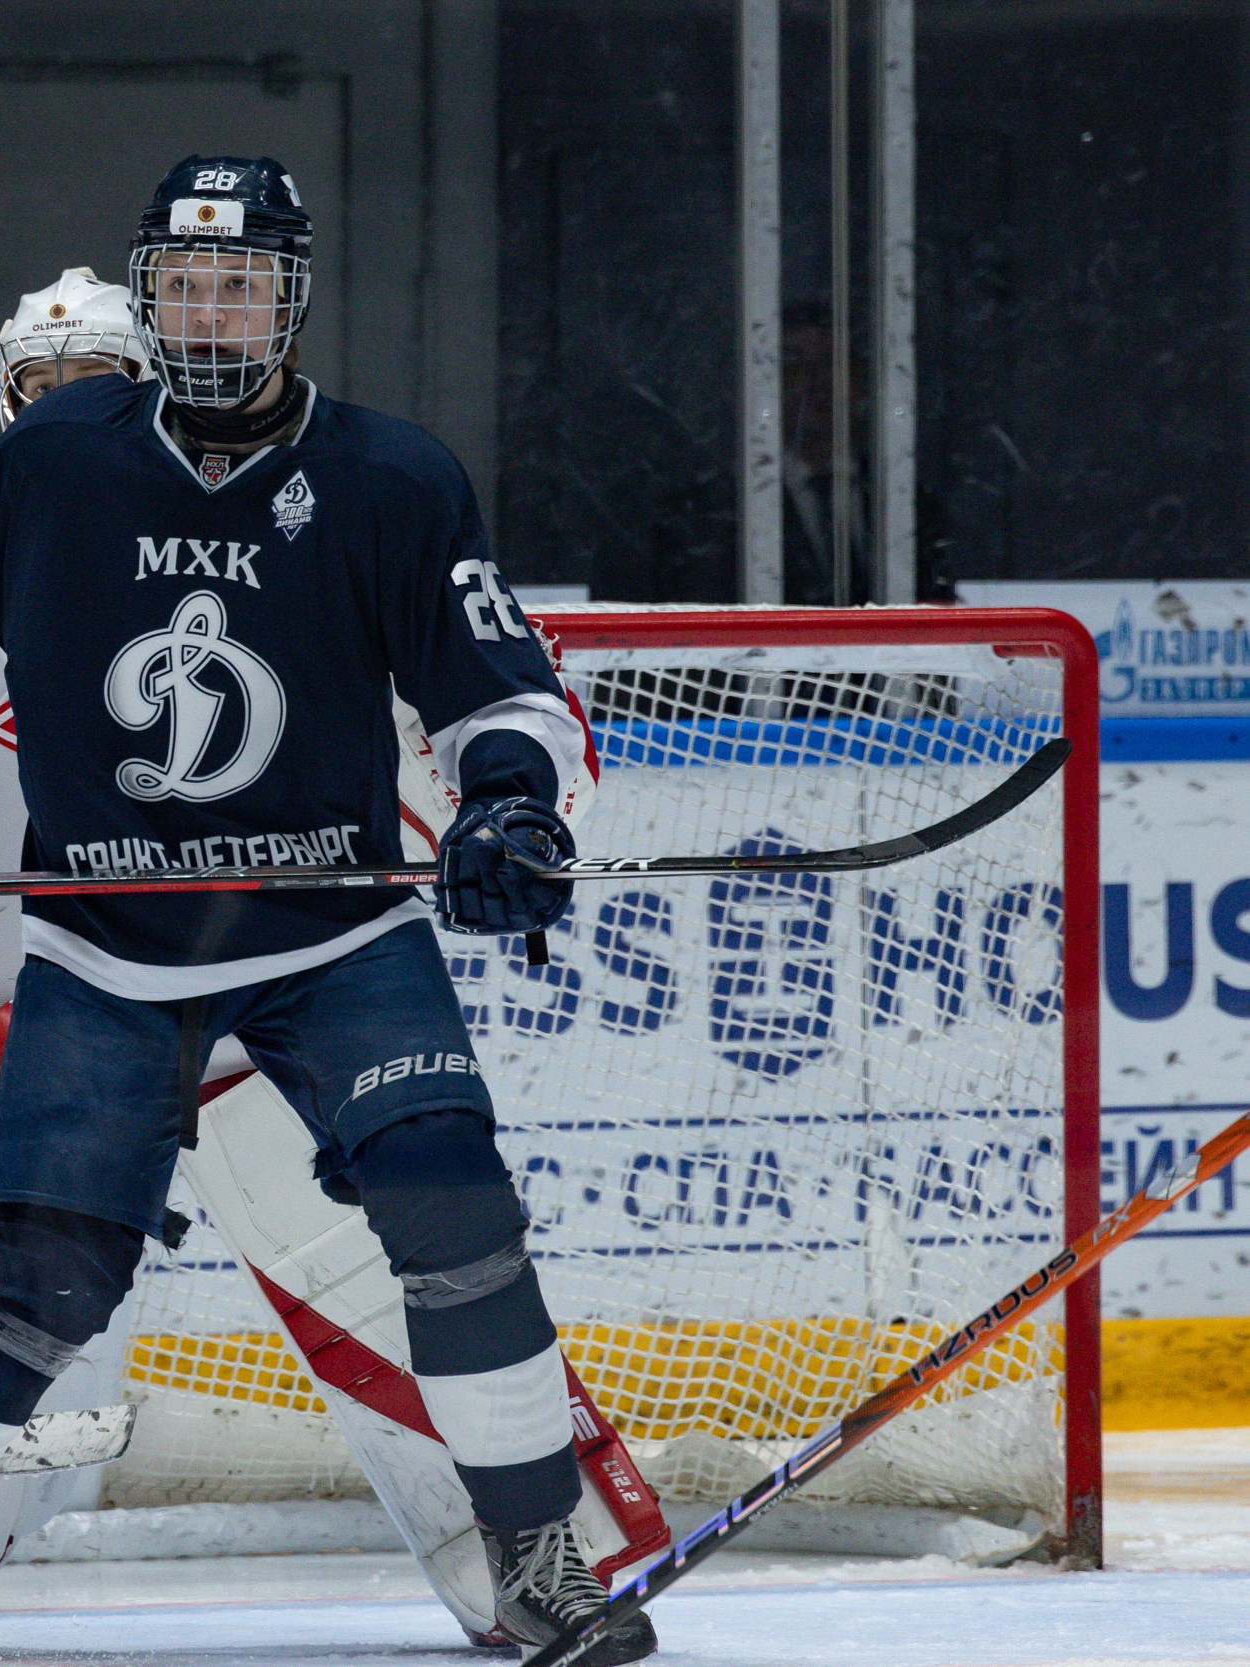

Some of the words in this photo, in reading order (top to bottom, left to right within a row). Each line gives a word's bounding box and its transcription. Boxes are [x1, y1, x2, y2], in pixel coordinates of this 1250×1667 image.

[194, 170, 238, 190] 28
[178, 225, 232, 235] OLIMPBET
[32, 320, 84, 332] OLIMPBET
[284, 505, 305, 520] 100
[275, 515, 312, 529] ДИНАМО
[135, 536, 261, 589] МХК
[1140, 629, 1250, 666] ГАЗПРО
[390, 874, 438, 884] BAUER
[909, 1248, 1078, 1385] HZRDUS
